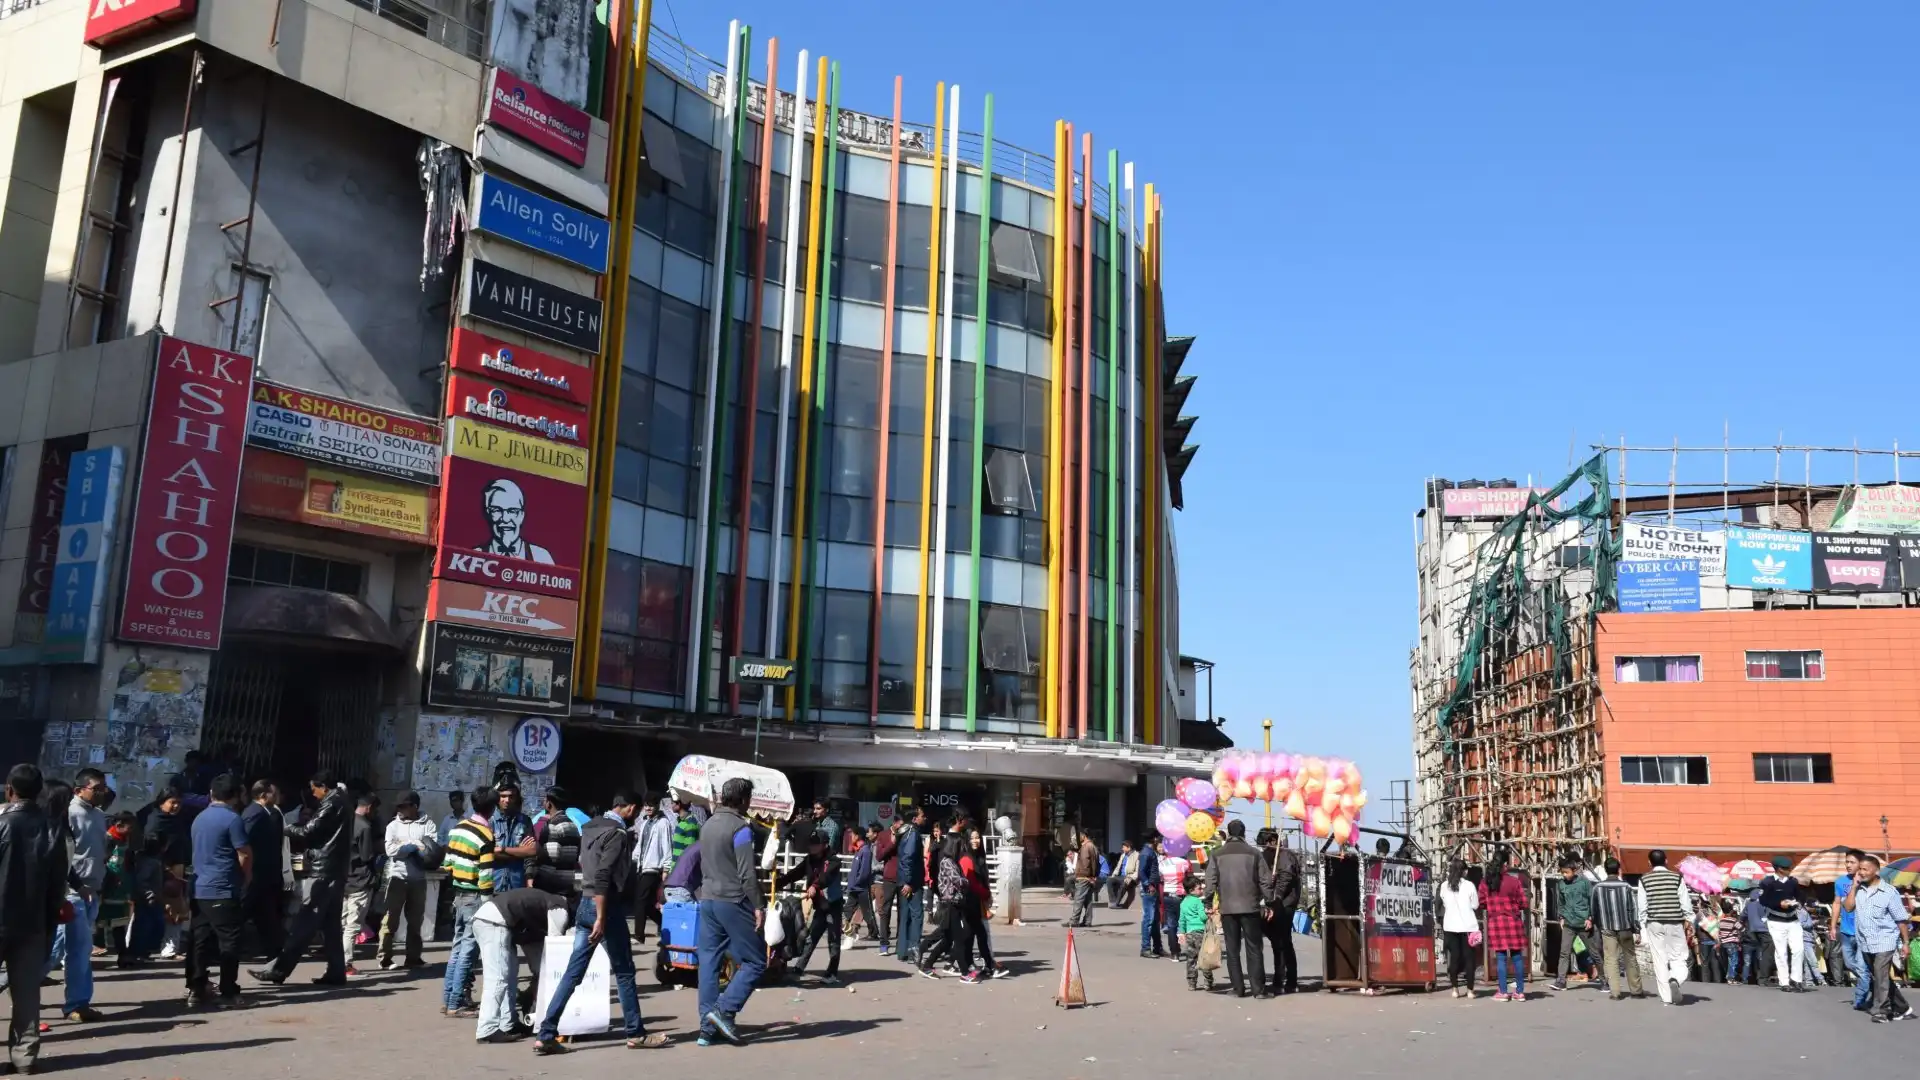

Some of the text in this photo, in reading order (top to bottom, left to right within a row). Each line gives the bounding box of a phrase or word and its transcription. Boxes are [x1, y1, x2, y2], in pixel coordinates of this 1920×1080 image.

[495, 87, 547, 124] Reliance
[490, 189, 600, 250] Allen Solly
[480, 352, 532, 380] Reliance
[255, 405, 437, 458] CASIO TITAN SONATA
[392, 424, 415, 438] ESTD
[252, 419, 437, 473] fastrack SEIKO CITIZEN
[459, 427, 584, 473] M. P. JEWELLERS
[277, 442, 332, 460] WATCHES
[346, 457, 415, 478] SPECTACLES
[81, 455, 96, 518] SBI
[151, 382, 226, 600] SHAHOO
[344, 500, 421, 523] SyndicateBank
[1640, 527, 1709, 543] HOTEL
[1789, 534, 1812, 544] MALL
[1816, 536, 1891, 547] O.B. SHOPPING MALL
[1625, 539, 1722, 555] BLUE MOUNT
[1628, 550, 1658, 559] POLICE
[1740, 540, 1800, 552] NOW OPEN
[1826, 545, 1882, 555] NOW OPEN
[448, 553, 572, 590] KFC @ 2ND FLOOR
[1619, 559, 1697, 574] CYBER CAFE
[1752, 575, 1786, 584] adidas
[60, 567, 78, 630] ATM
[480, 591, 540, 618] KFC
[144, 603, 204, 620] WATCHES
[499, 613, 514, 624] THIS
[515, 617, 530, 626] WAY
[130, 622, 212, 641] SPECTACLES
[439, 628, 572, 654] Kosmic Kingdom
[739, 662, 793, 679] SUBWAY
[524, 723, 552, 747] BR
[1381, 867, 1414, 888] POLICE
[1375, 898, 1421, 919] CHECKING
